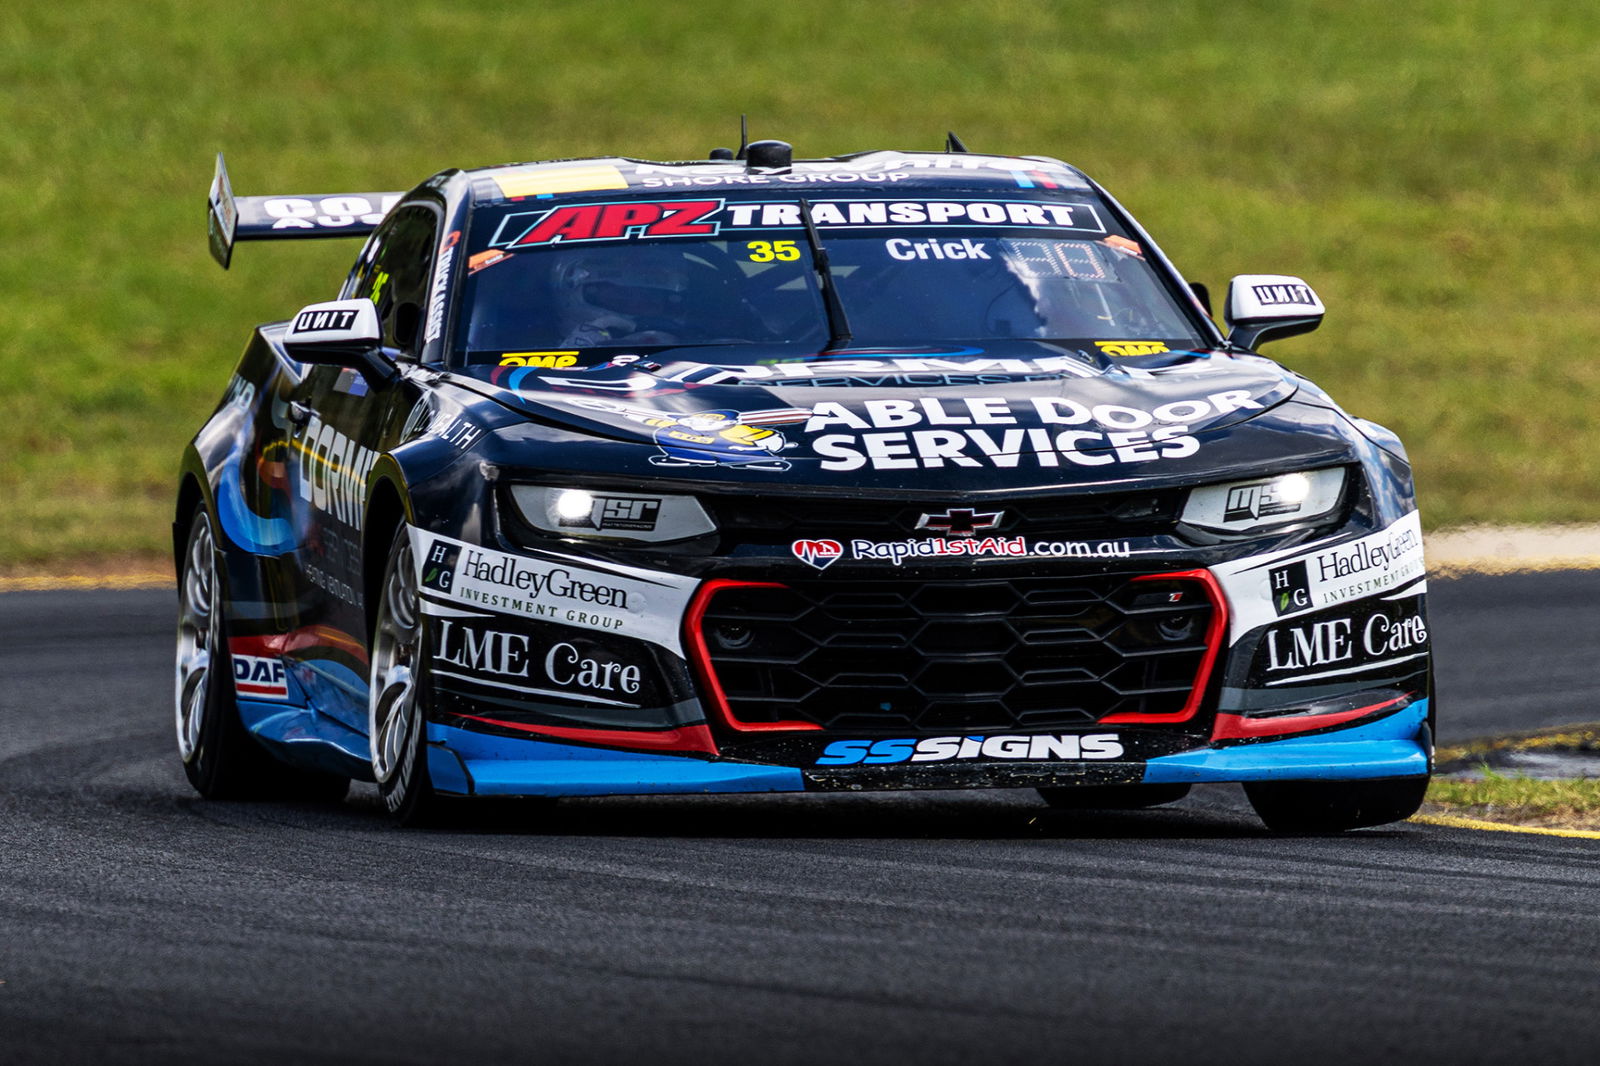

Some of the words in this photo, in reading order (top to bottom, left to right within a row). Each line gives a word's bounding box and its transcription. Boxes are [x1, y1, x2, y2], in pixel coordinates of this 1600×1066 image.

[641, 175, 771, 188] SHORE
[778, 171, 912, 184] GROUP
[514, 201, 720, 244] APZ
[726, 202, 1074, 226] TRANSPORT
[746, 240, 802, 263] 35
[885, 238, 992, 261] Crick
[804, 397, 1018, 433] ABLE
[1029, 390, 1265, 430] DOOR
[811, 425, 1201, 472] SERVICES
[852, 537, 1131, 565] Rapid1stAid.com.au
[462, 549, 630, 610] HadleyGreen
[459, 586, 559, 618] INVESTMENT
[566, 610, 625, 630] GROUP
[432, 619, 530, 677] LME
[544, 642, 641, 694] Care
[1266, 617, 1353, 672] LME
[1363, 613, 1428, 656] Care
[233, 658, 286, 683] DAF
